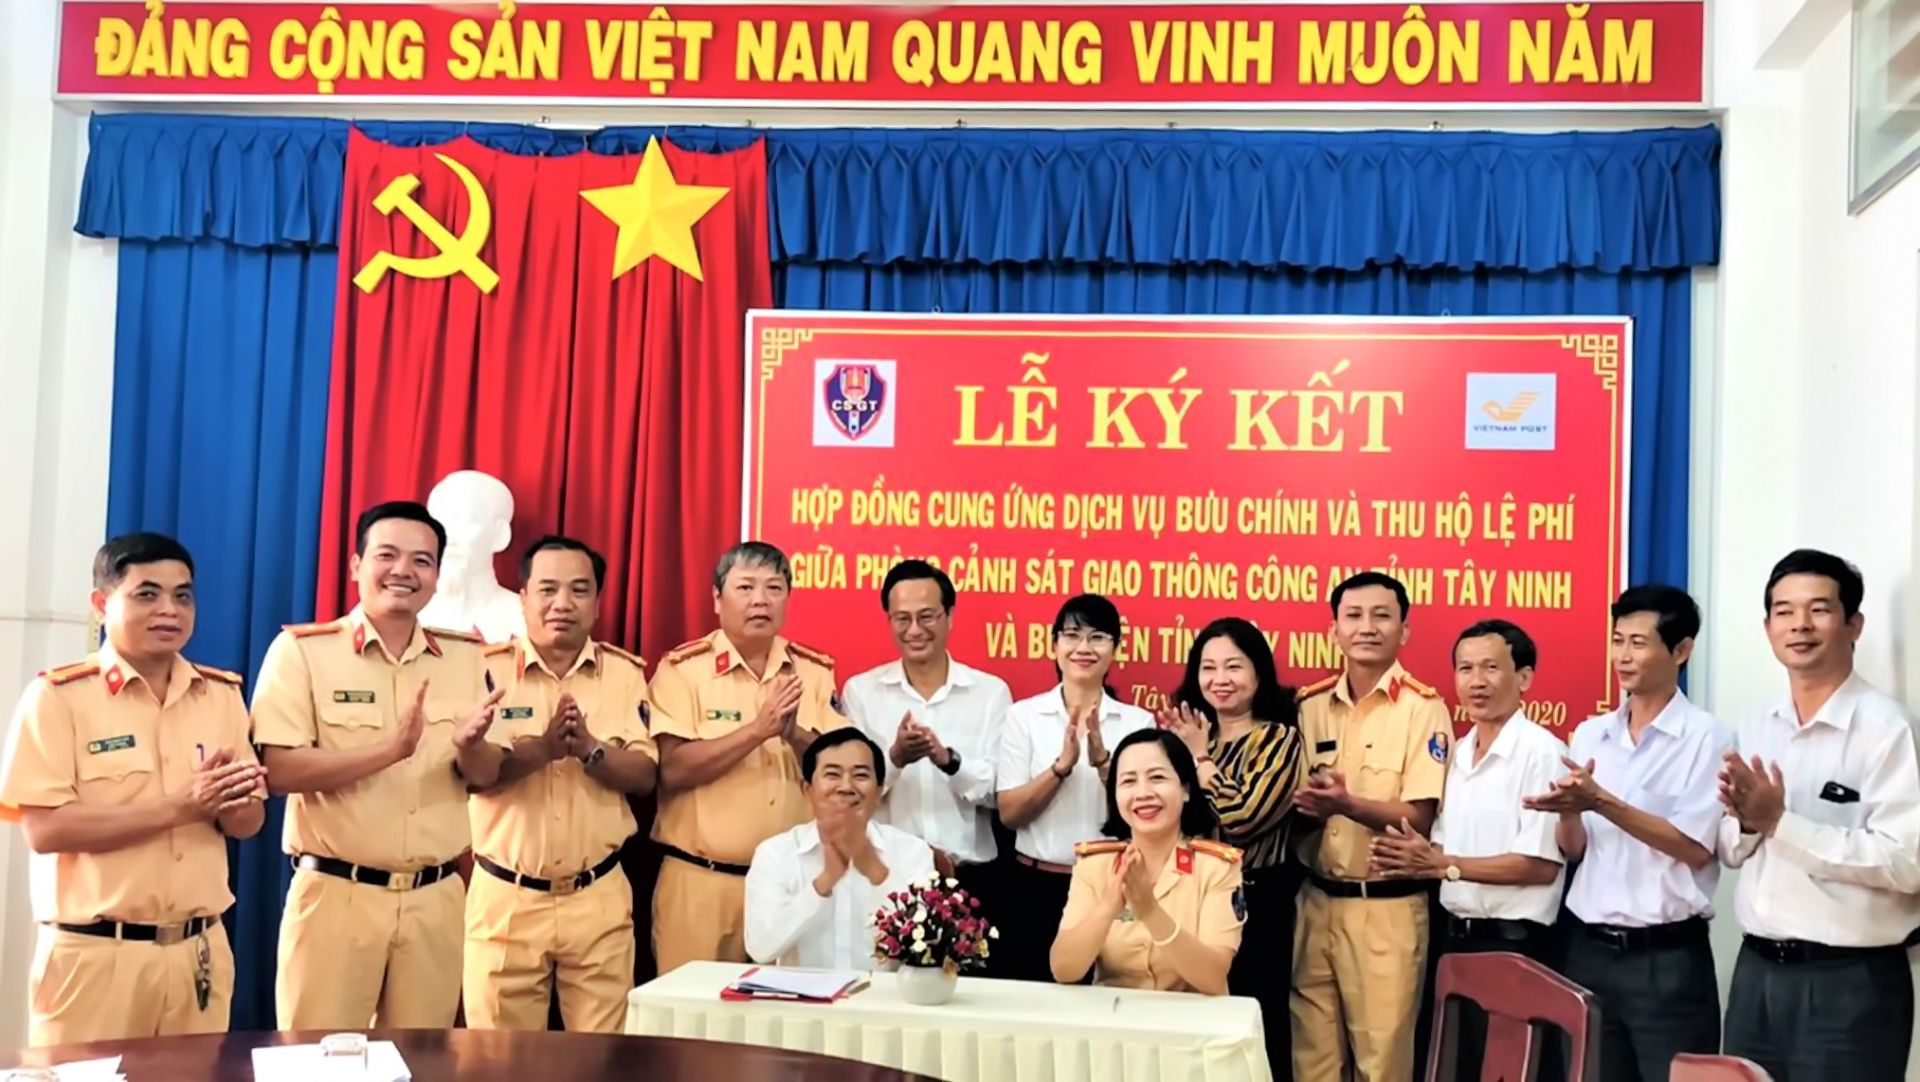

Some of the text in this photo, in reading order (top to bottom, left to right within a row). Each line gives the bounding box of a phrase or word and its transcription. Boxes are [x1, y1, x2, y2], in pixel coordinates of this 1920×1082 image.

[95, 0, 1653, 94] ĐẢNG CỘNG SẢN VIỆT NAM QUANG VINH MUÔN NĂM
[953, 351, 1404, 453] LỄ KÝ KẾT
[1473, 424, 1517, 432] VIETNAM
[791, 474, 1576, 546] HỢP ĐỒNG CUNG ỨNG DỊCH VỤ BƯU CHÍNH VÀ THU HỘ LỆ PHÍ
[790, 544, 1573, 609] GIỮA PHÒ CẢNH SÁT GIAO THÔNG CÔNG A ỈNH TÂY NINH
[985, 612, 1018, 659] VÀ
[1157, 614, 1201, 665] TỈN
